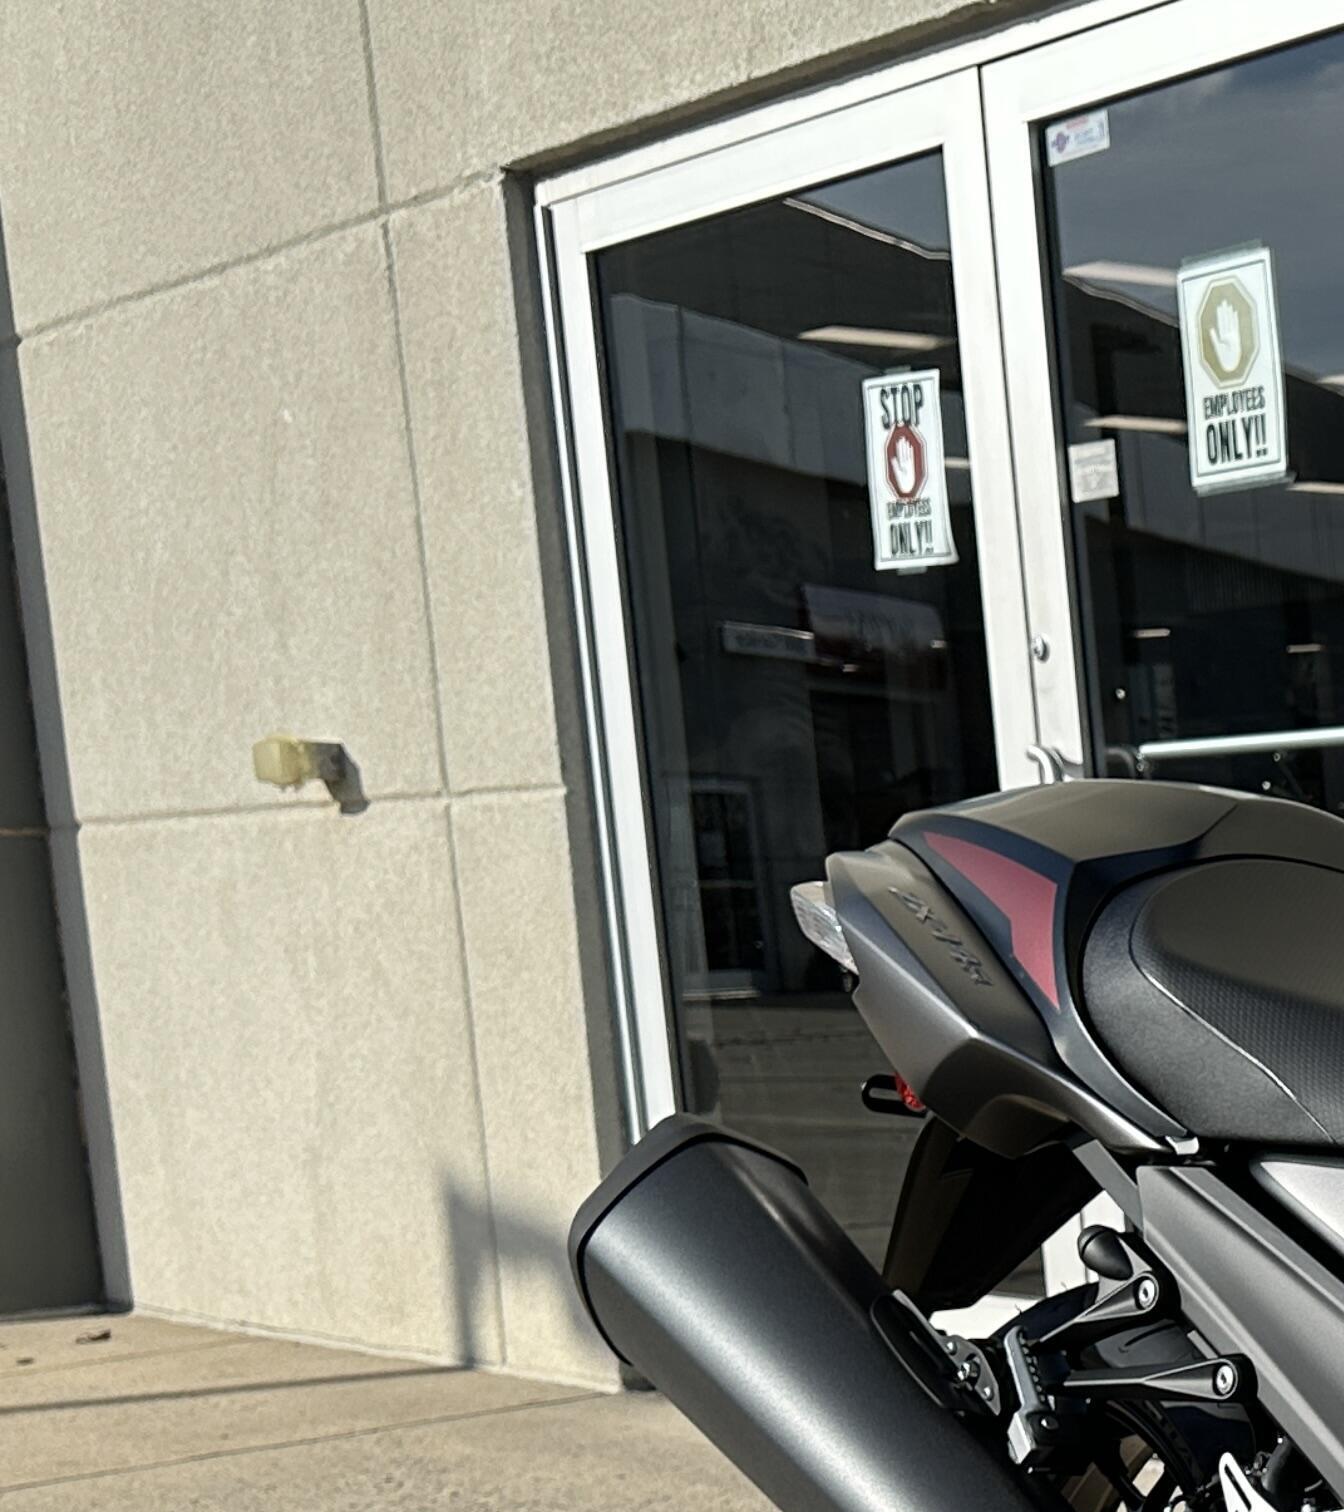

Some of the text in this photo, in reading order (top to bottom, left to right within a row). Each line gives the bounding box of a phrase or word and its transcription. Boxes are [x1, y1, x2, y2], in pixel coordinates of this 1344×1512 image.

[880, 383, 924, 430] STOP
[1203, 385, 1267, 420] EMPLOYEES
[1207, 413, 1269, 465] ONLY!!
[889, 519, 935, 556] ONLY!!
